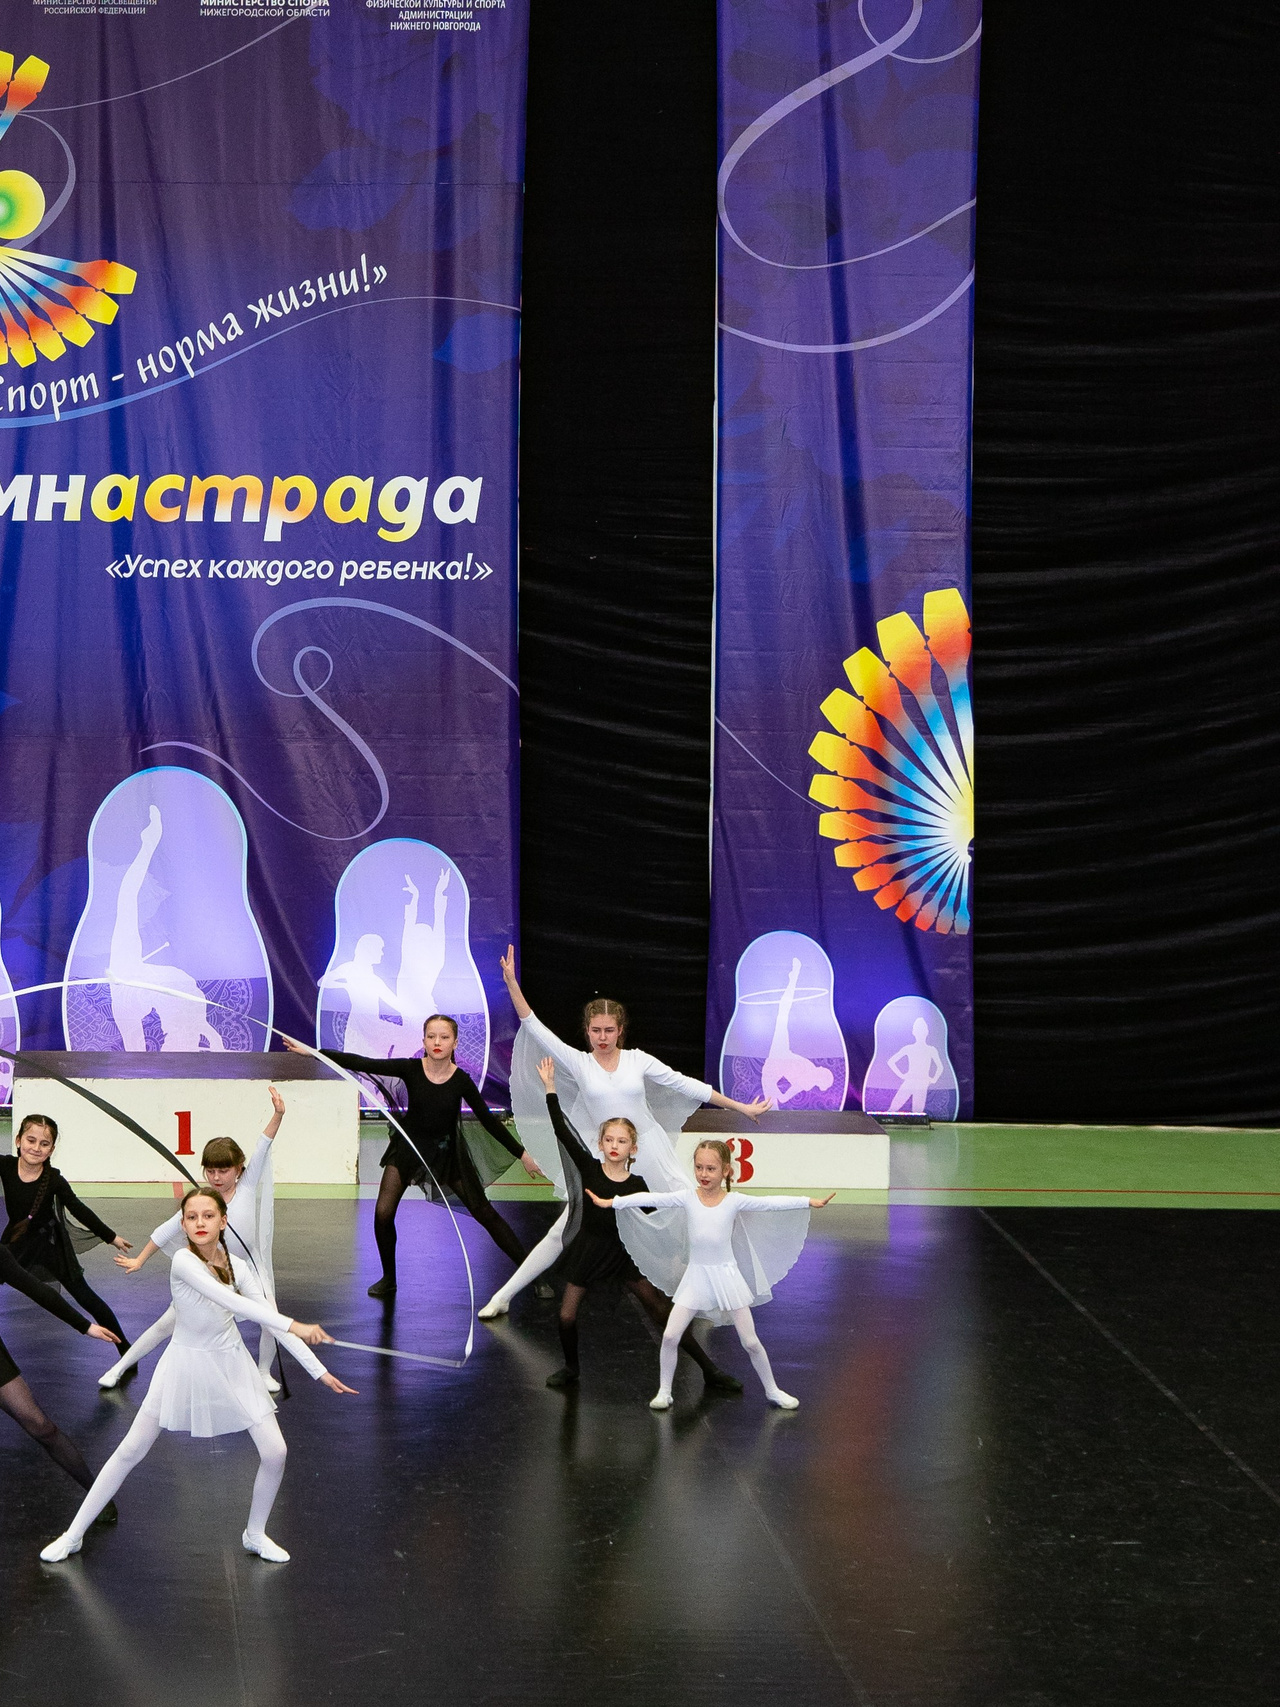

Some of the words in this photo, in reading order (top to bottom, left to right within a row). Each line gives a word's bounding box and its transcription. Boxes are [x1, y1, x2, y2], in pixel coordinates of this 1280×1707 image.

[365, 0, 422, 9] ФИЗИЧЕСКОЙ
[423, 0, 464, 9] КУЛЬТУРЫ
[474, 0, 506, 9] СПОРТА
[44, 6, 97, 14] РОССИЙСКОЙ
[98, 7, 146, 15] ФЕДЕРАЦИИ
[200, 7, 284, 17] НИЖЕГОРОДСКОЙ
[286, 8, 330, 17] ОБЛАСТИ
[398, 10, 473, 20] АДМИНИСТРАЦИИ
[390, 21, 431, 31] НИЖНЕГО
[432, 21, 481, 32] НОВГОРОДА
[136, 311, 244, 384] норма
[247, 253, 388, 329] жизни!»
[105, 554, 204, 579] «Успех
[208, 559, 335, 587] каждого
[339, 553, 494, 587] ребенка!»
[175, 1110, 195, 1155] 1
[725, 1137, 755, 1183] 3
